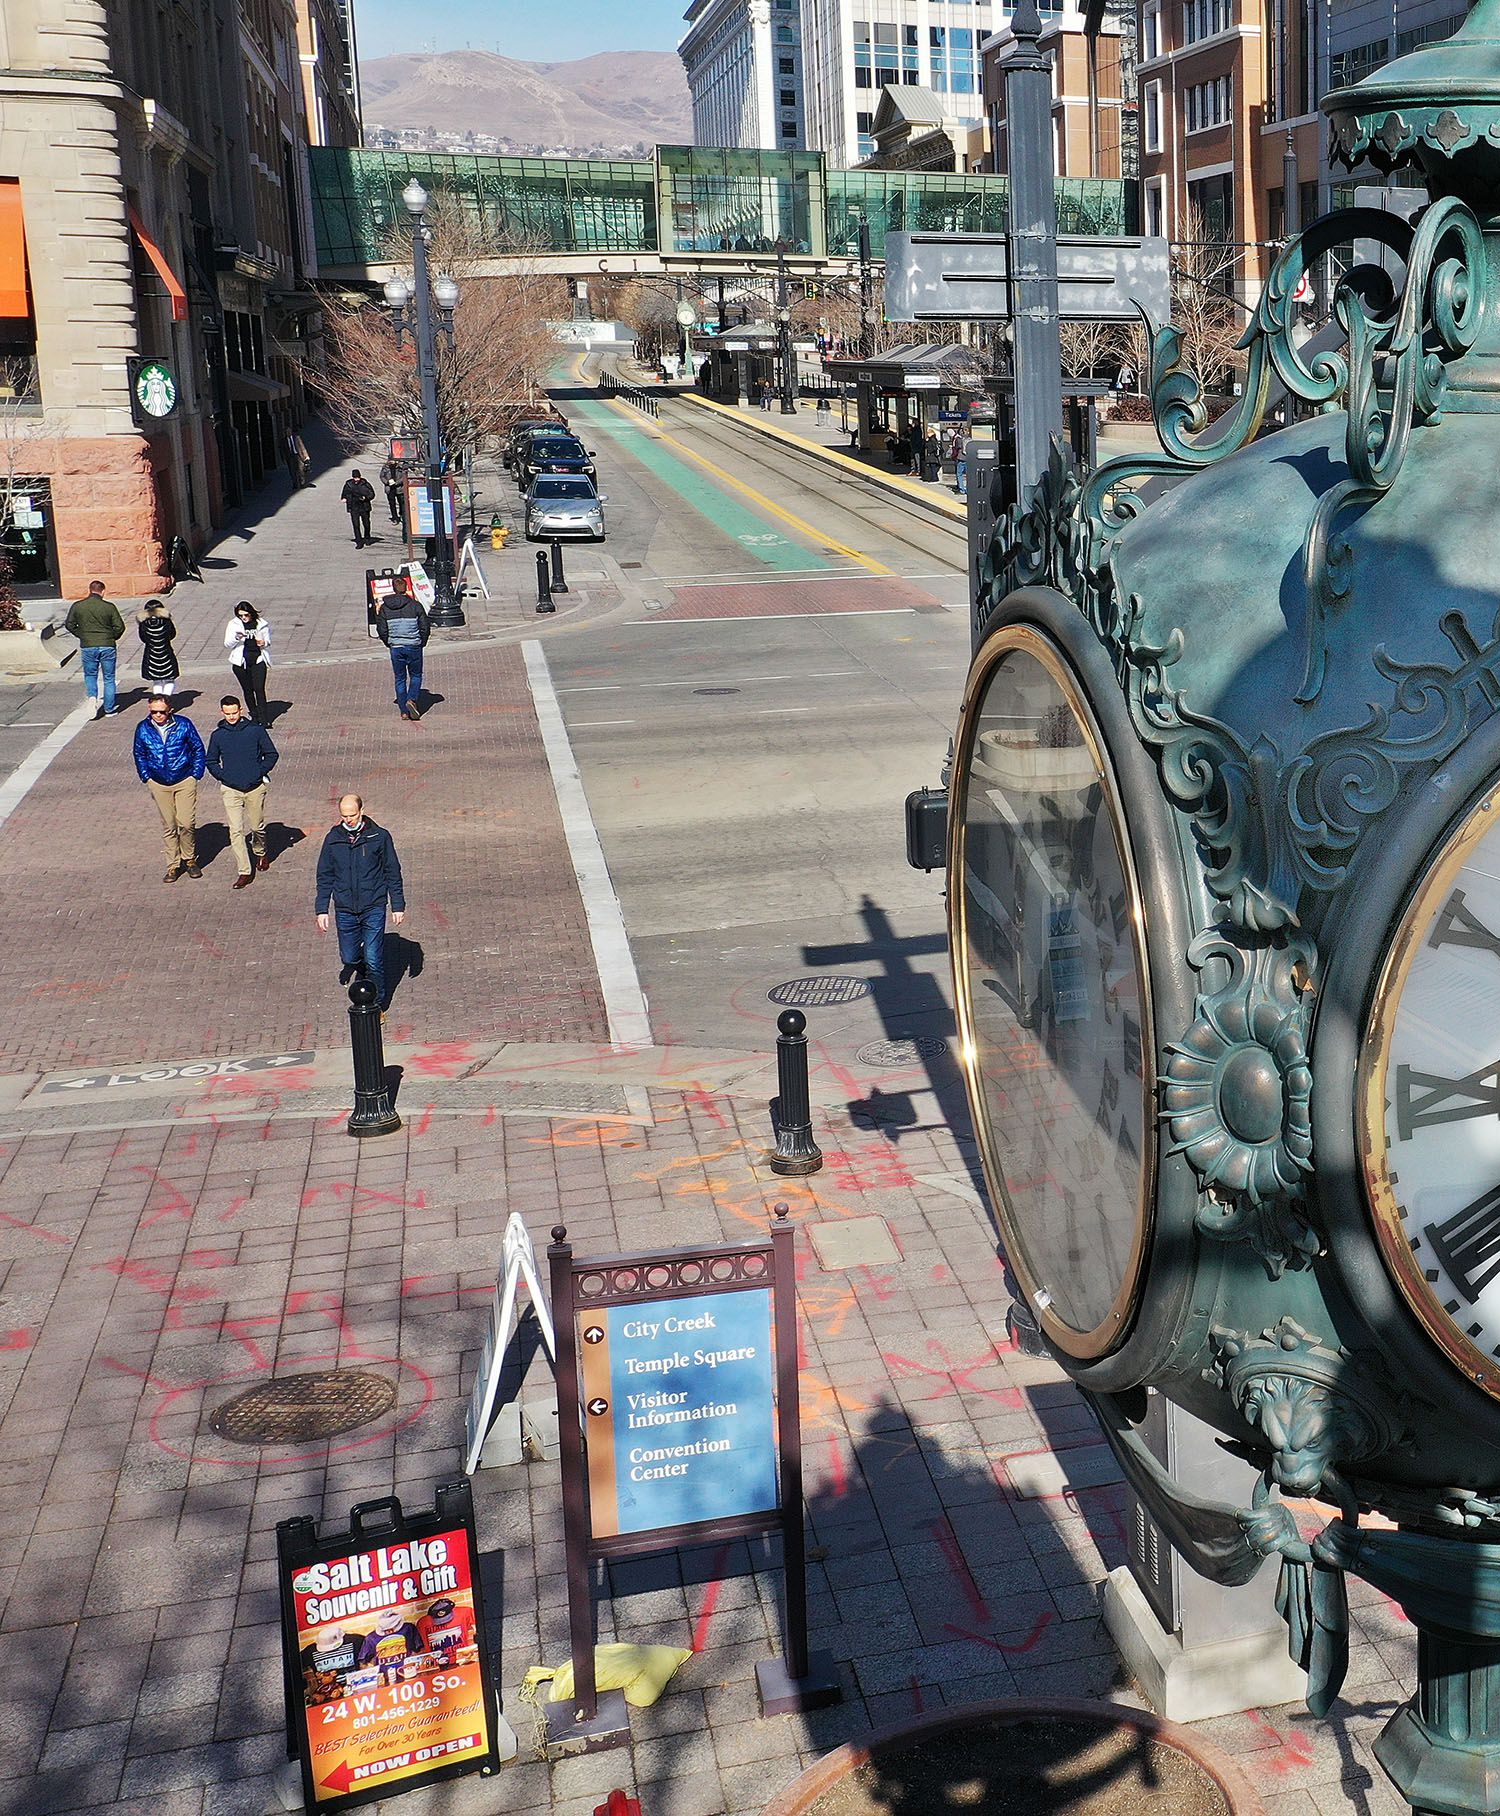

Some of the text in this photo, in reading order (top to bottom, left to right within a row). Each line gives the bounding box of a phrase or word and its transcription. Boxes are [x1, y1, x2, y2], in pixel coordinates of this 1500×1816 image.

[108, 1059, 250, 1086] LOOK
[623, 1312, 716, 1340] City Creek
[625, 1347, 755, 1374] Temple Square
[627, 1390, 688, 1410] Visitor
[628, 1402, 737, 1429] Information
[629, 1438, 731, 1464] Convention
[630, 1463, 689, 1482] Center
[309, 1540, 447, 1595] Salt Lake
[305, 1565, 458, 1624] Souvenir & Gift
[323, 1655, 353, 1666] UTAH
[380, 1654, 407, 1665] UTAH
[322, 1675, 467, 1724] 24 W. 100 So.
[353, 1696, 440, 1729] 801-456-1229
[315, 1736, 349, 1756] BEST
[350, 1723, 405, 1745] Selection
[359, 1727, 442, 1756] For Over 30 Years
[354, 1735, 474, 1780] NOW OPEN
